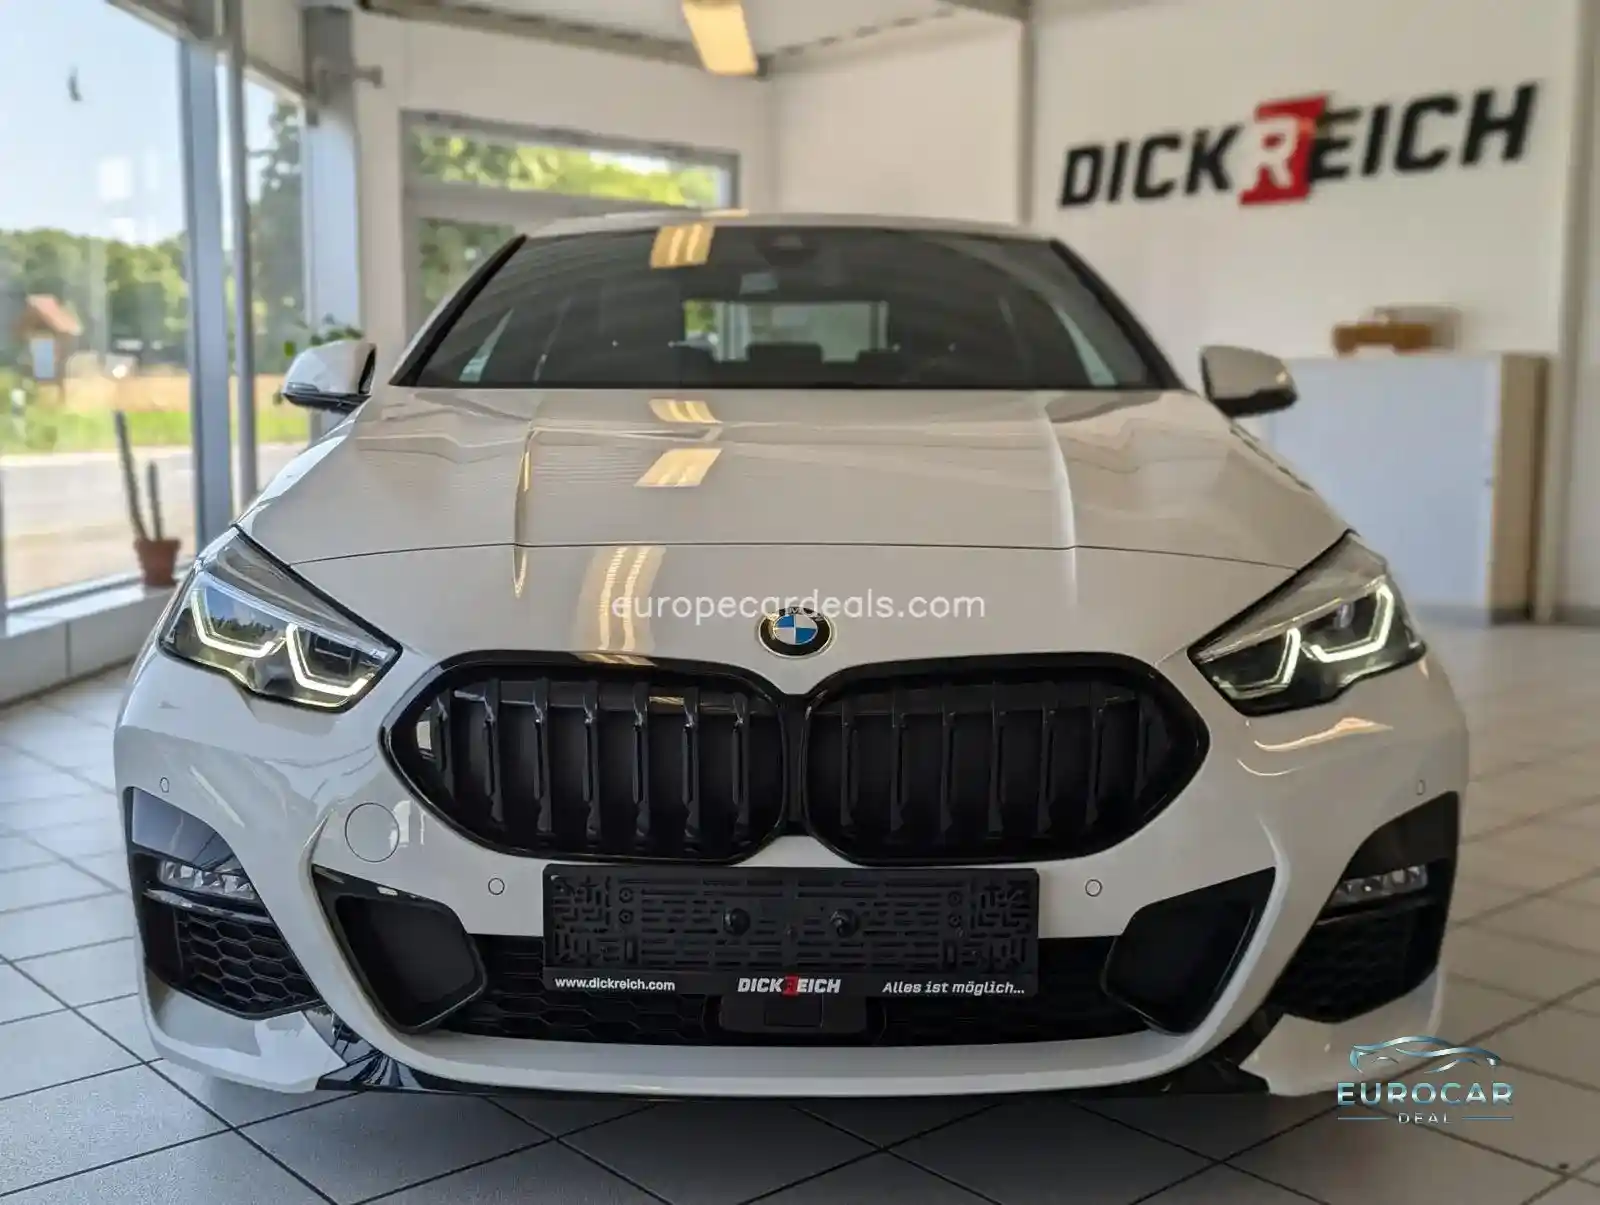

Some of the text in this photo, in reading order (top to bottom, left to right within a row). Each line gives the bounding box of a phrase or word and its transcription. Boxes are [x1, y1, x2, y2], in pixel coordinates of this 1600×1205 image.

[1058, 81, 1539, 207] DICKREICH
[555, 977, 675, 991] www.dickreich.com
[882, 981, 1025, 996] Alles ist möglich...
